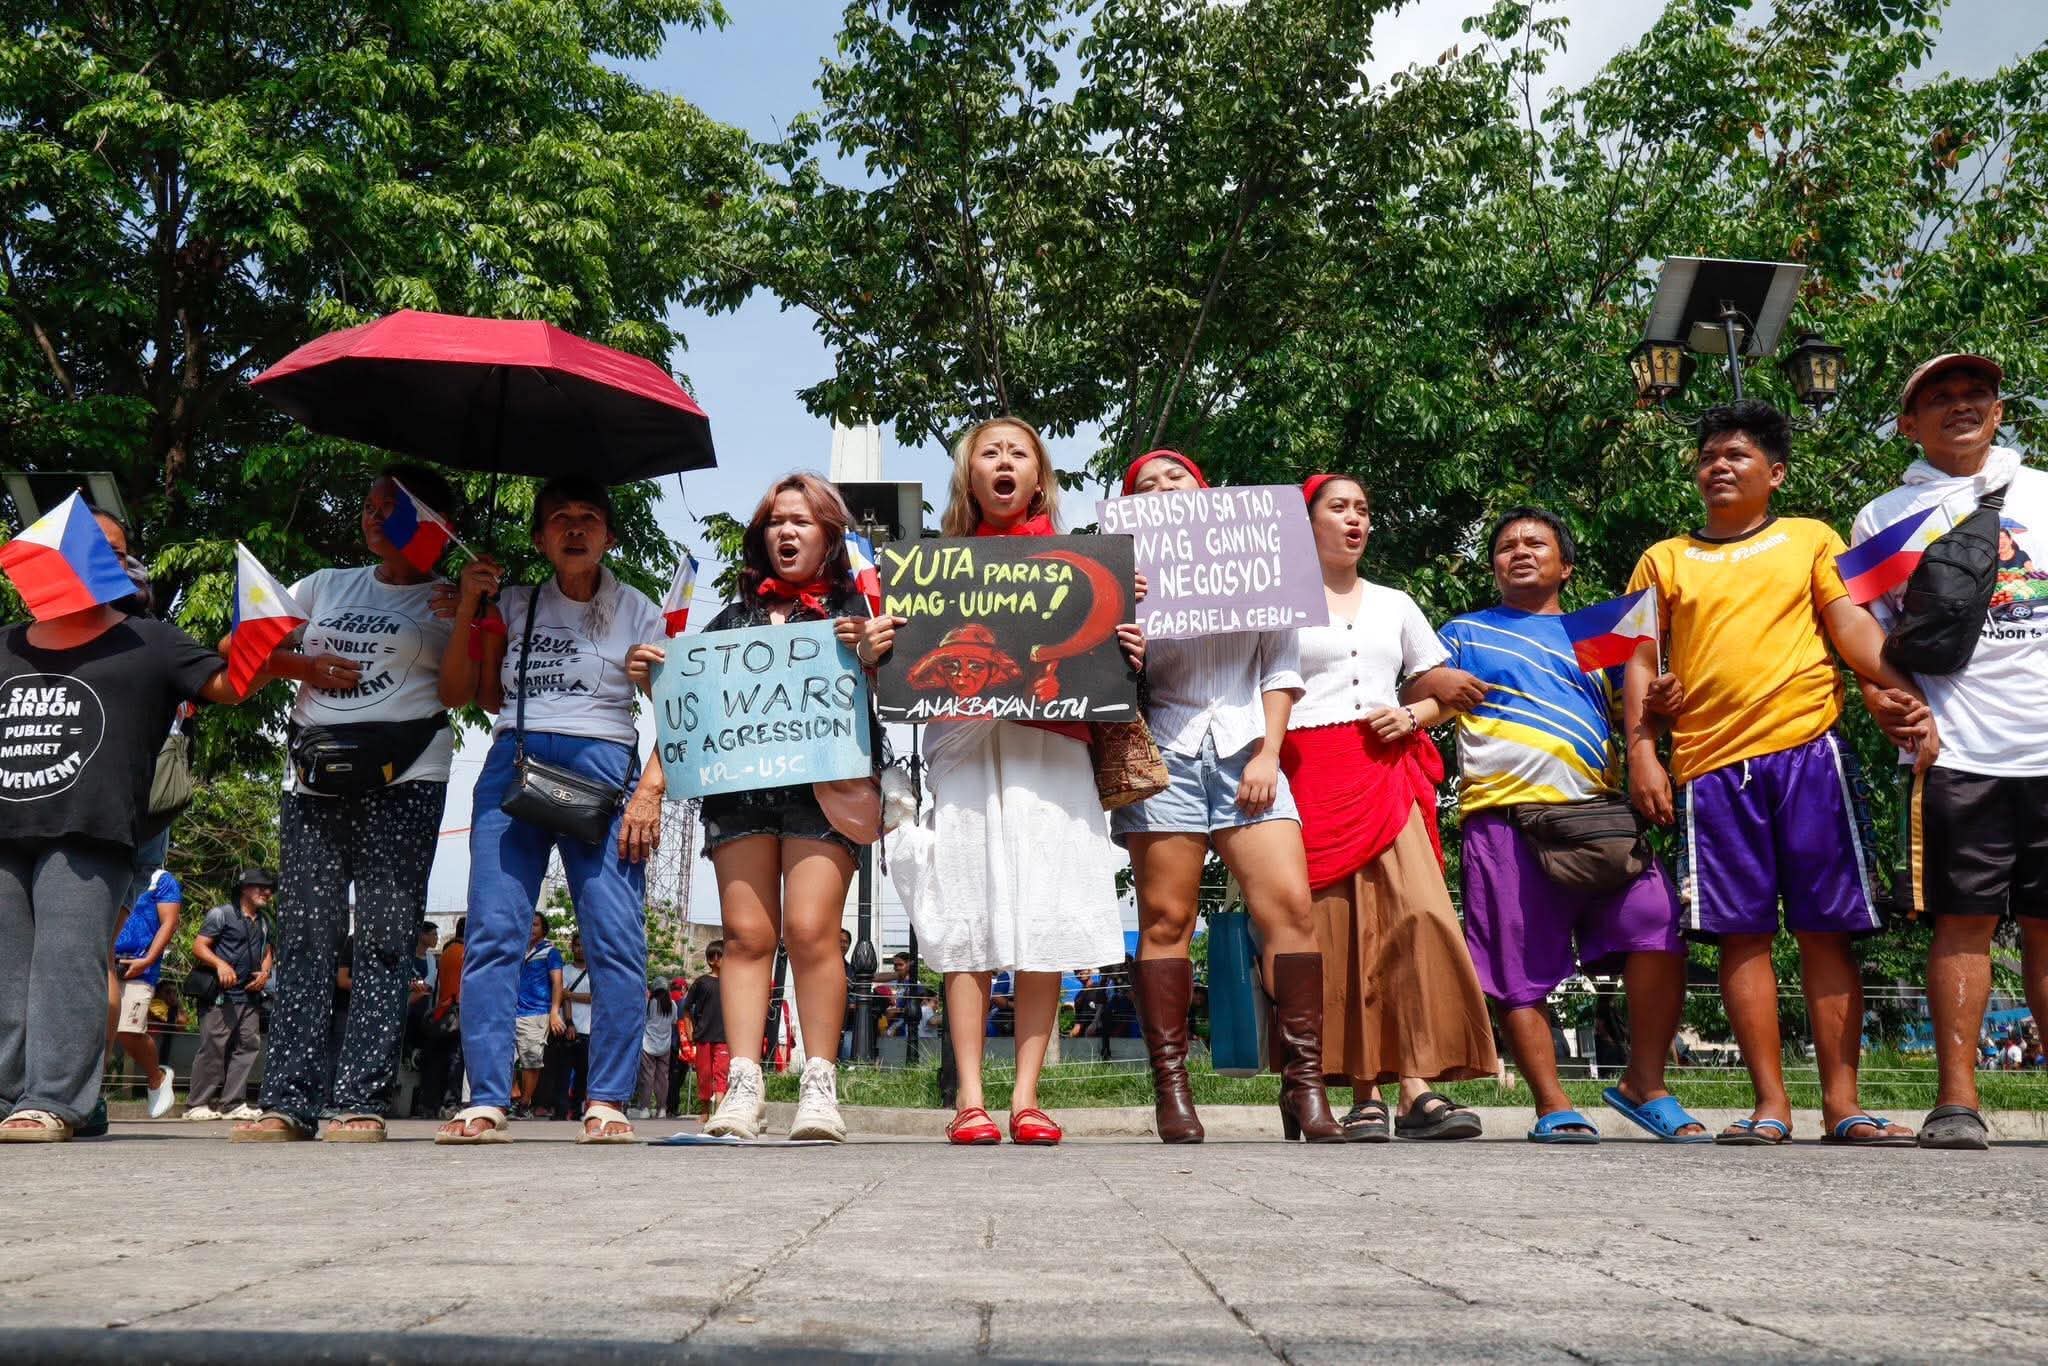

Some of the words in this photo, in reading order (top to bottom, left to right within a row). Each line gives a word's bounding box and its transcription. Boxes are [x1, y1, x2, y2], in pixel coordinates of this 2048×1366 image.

[1104, 491, 1209, 533] SERBISYO
[1212, 492, 1236, 522] SA
[1133, 530, 1193, 564] WAG
[1205, 522, 1281, 557] GAWING
[884, 545, 975, 586] YUTA
[983, 563, 1041, 586] PARA
[1043, 563, 1073, 583] SA
[1159, 554, 1282, 600] NEGOSYO!
[318, 618, 401, 635] CARBON
[681, 637, 821, 677] STOP
[10, 686, 67, 703] SAVE
[665, 691, 699, 732] US
[722, 674, 858, 718] WARS
[0, 742, 62, 758] MARKET
[5, 724, 63, 739] PUBLIC
[664, 740, 688, 764] OF
[702, 716, 851, 754] AGRESSION
[0, 751, 81, 789] VEMENT
